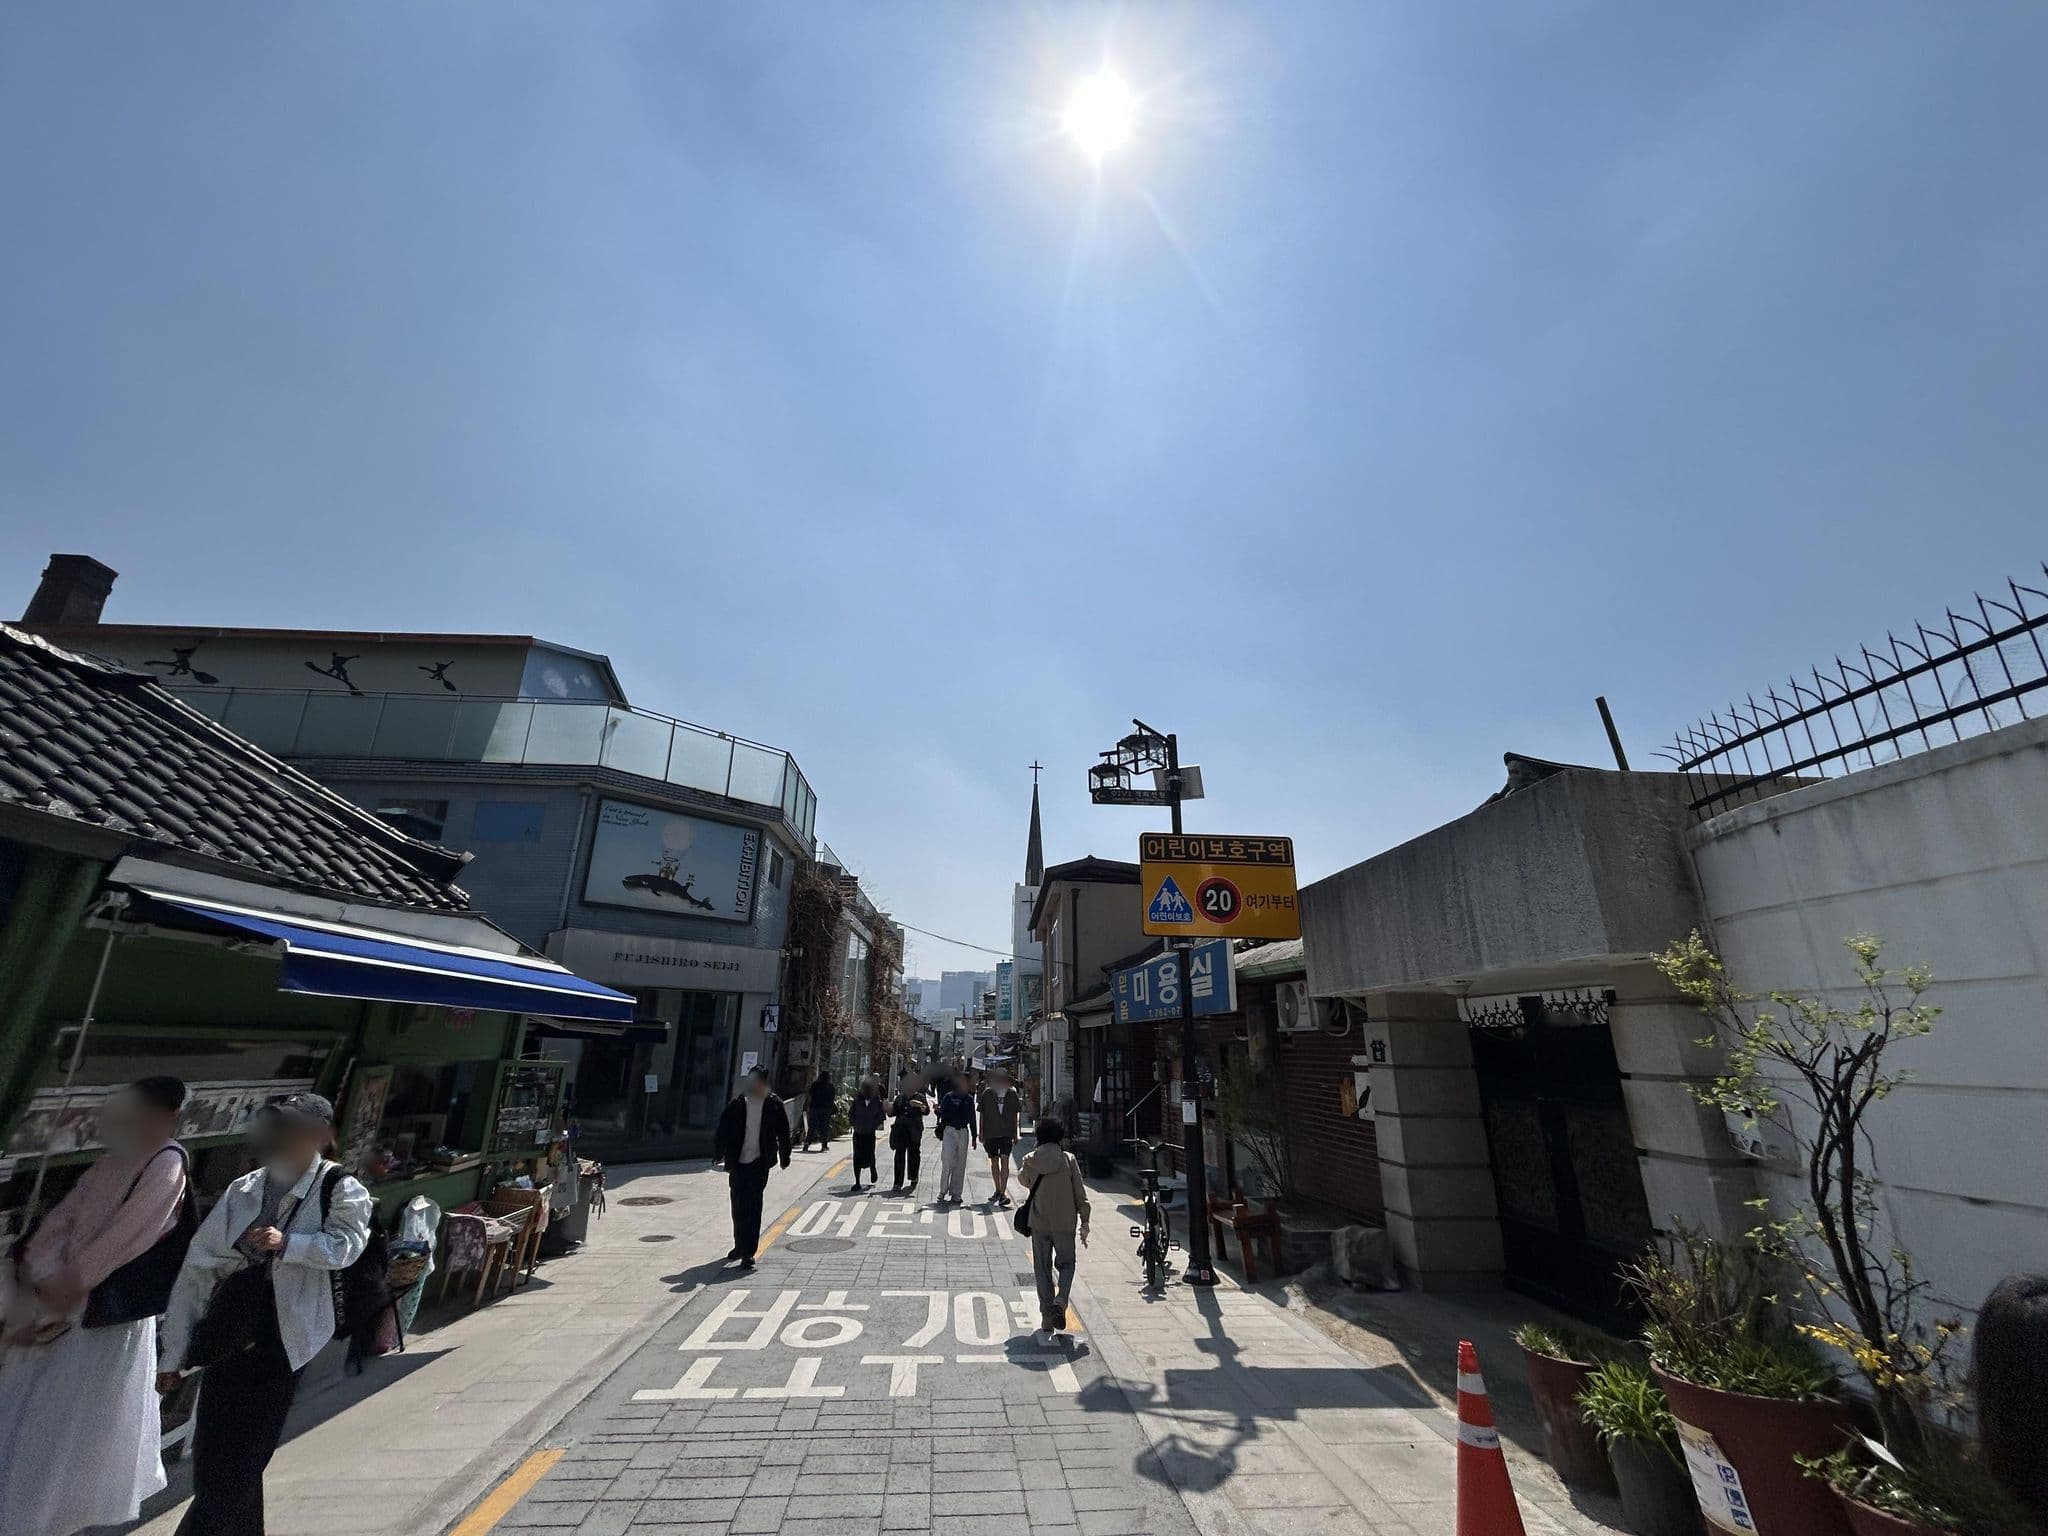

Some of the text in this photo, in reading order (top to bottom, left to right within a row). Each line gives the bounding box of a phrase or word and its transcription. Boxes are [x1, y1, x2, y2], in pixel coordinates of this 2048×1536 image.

[1147, 839, 1286, 862] 어린이보호구역
[734, 832, 756, 914] EXHIBITION
[1206, 889, 1232, 912] 20
[1246, 894, 1296, 910] 여기부터
[1150, 911, 1192, 922] 어린이보호
[614, 951, 740, 972] FUJISHIRO SEIJI
[1132, 952, 1214, 1006] 미용실
[786, 1199, 1016, 1241] 어린이
